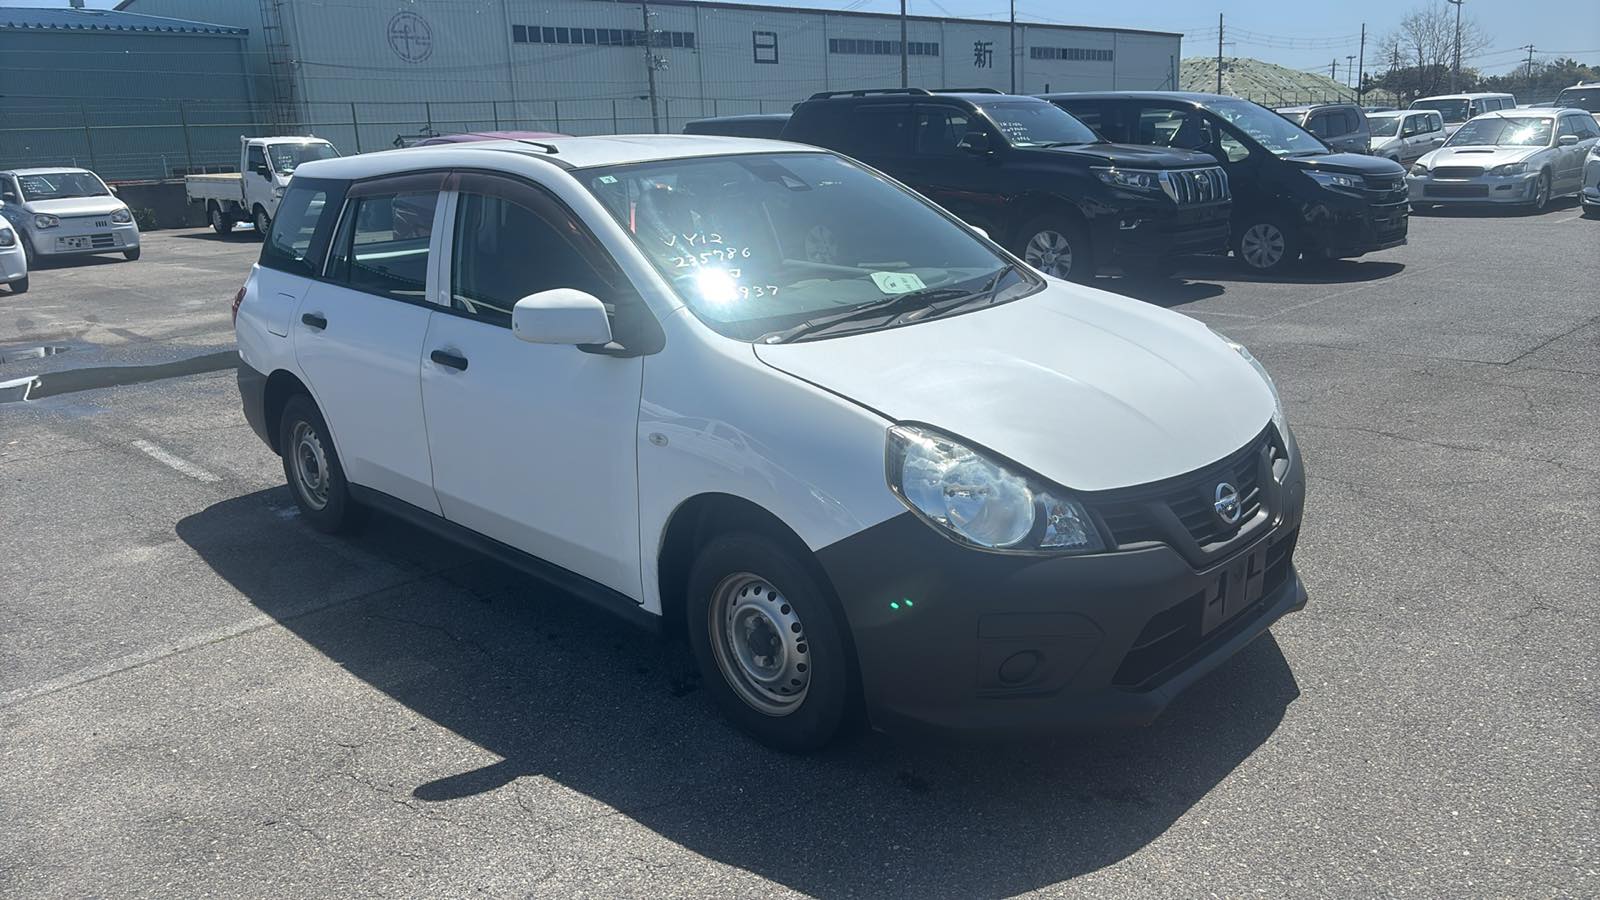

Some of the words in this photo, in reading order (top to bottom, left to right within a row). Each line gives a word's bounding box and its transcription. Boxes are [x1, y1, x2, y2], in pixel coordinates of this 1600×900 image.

[752, 30, 779, 64] 日
[974, 40, 993, 69] 新
[674, 247, 752, 268] 235786
